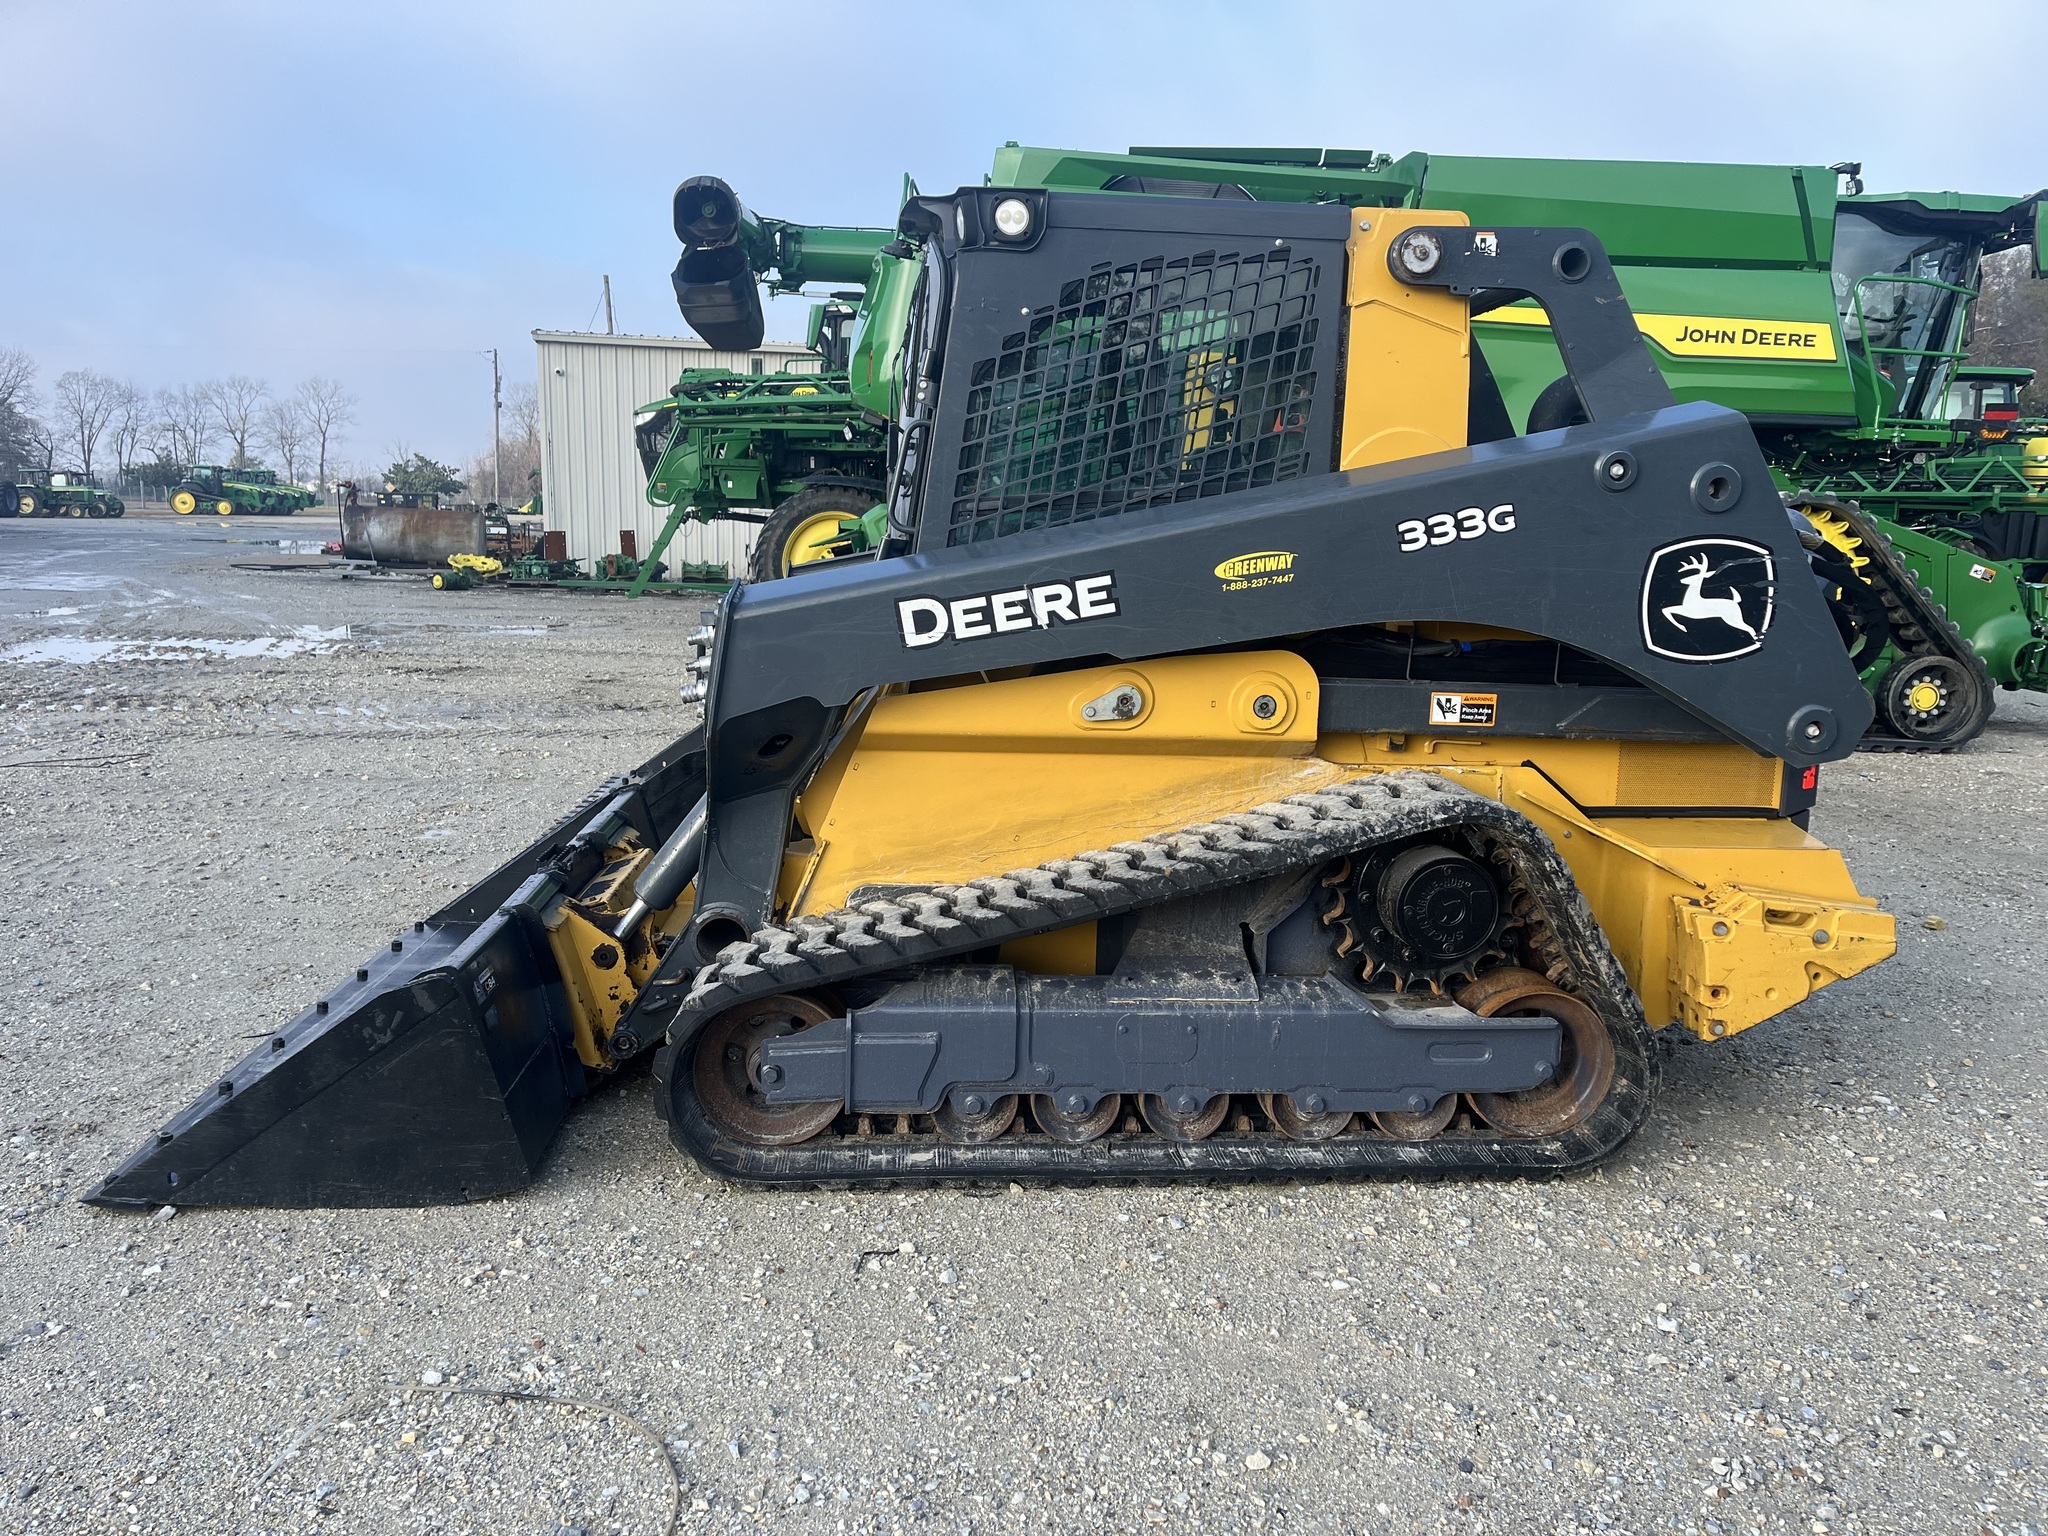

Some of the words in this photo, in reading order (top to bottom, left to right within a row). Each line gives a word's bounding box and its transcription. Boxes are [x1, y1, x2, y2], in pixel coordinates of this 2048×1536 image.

[1676, 326, 1737, 344] JOHN
[1741, 328, 1817, 348] DEERE
[1397, 503, 1517, 553] 333G
[1224, 553, 1294, 578] GREENWAY
[1221, 573, 1295, 592] 1-888-237-7447
[898, 574, 1117, 648] DEERE
